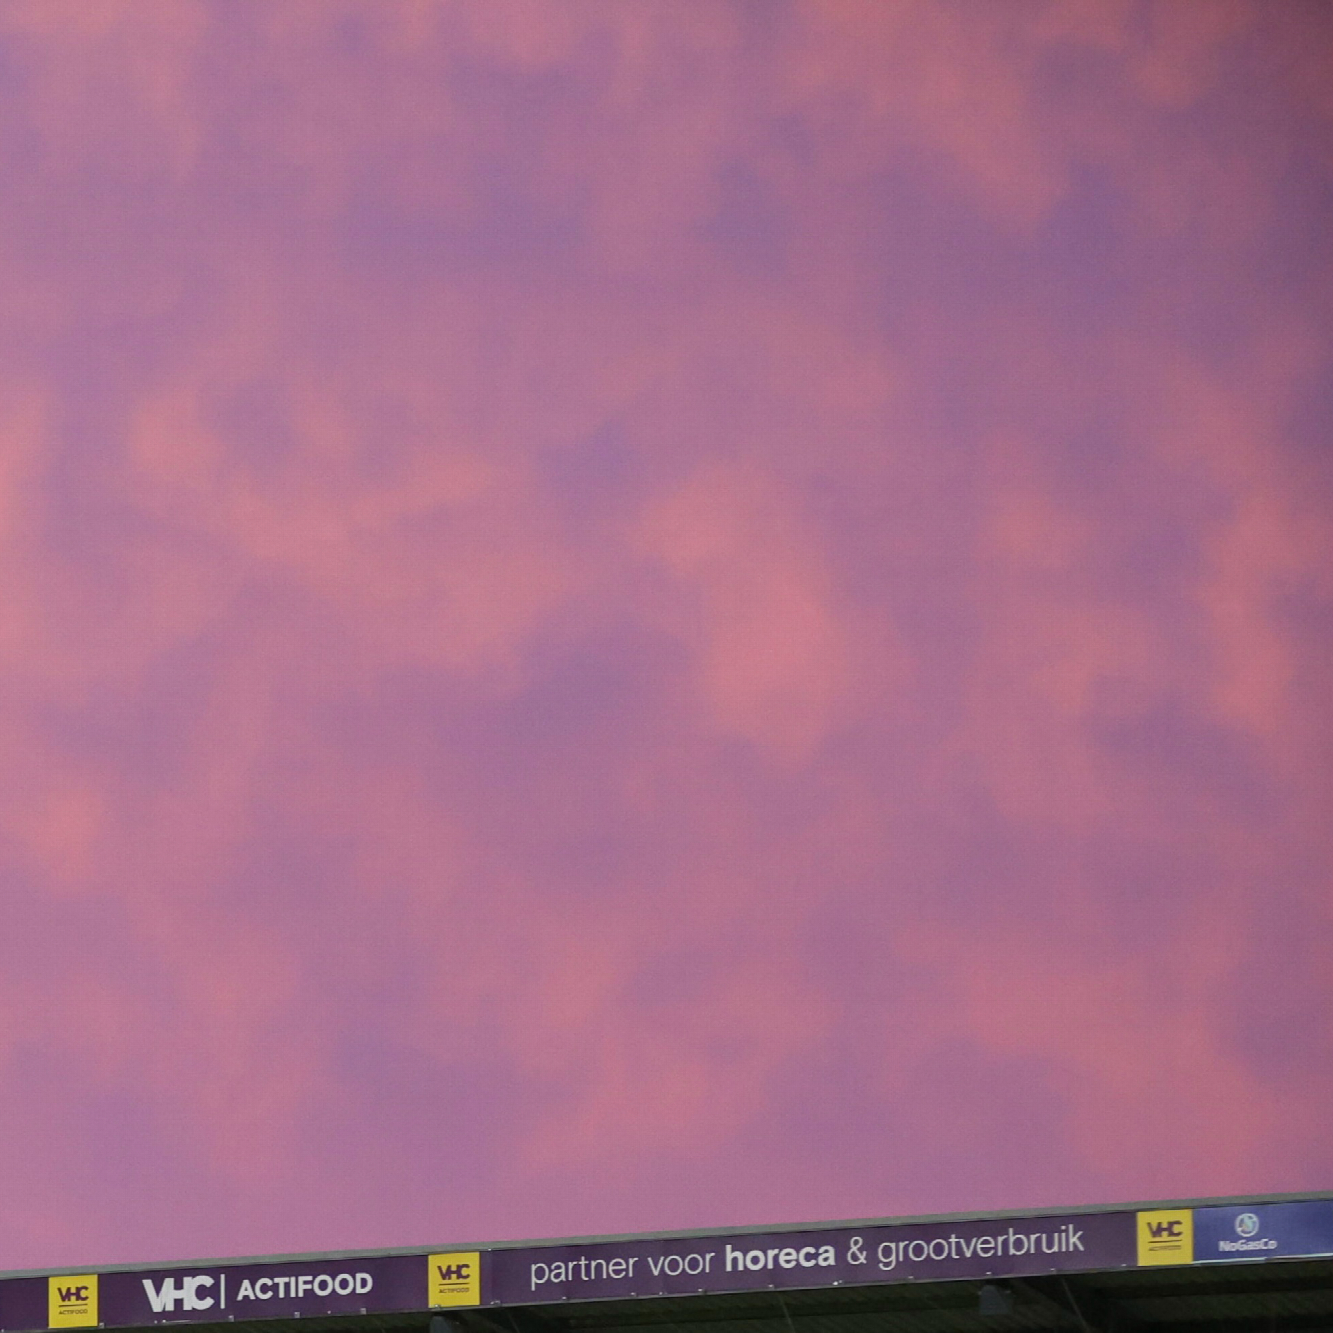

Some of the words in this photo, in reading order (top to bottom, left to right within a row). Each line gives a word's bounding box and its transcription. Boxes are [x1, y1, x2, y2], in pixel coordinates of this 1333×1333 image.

[1147, 1220, 1183, 1238] VHC
[1218, 1238, 1278, 1251] NoGasCo
[531, 1252, 639, 1291] partner
[647, 1251, 714, 1278] voor
[725, 1241, 836, 1272] horeca
[847, 1236, 867, 1265] &
[877, 1224, 1085, 1271] grootverbruik
[437, 1263, 471, 1280] VHC
[57, 1285, 89, 1302] VHC
[143, 1276, 215, 1313] VHC
[237, 1273, 373, 1301] ACTIFOOD
